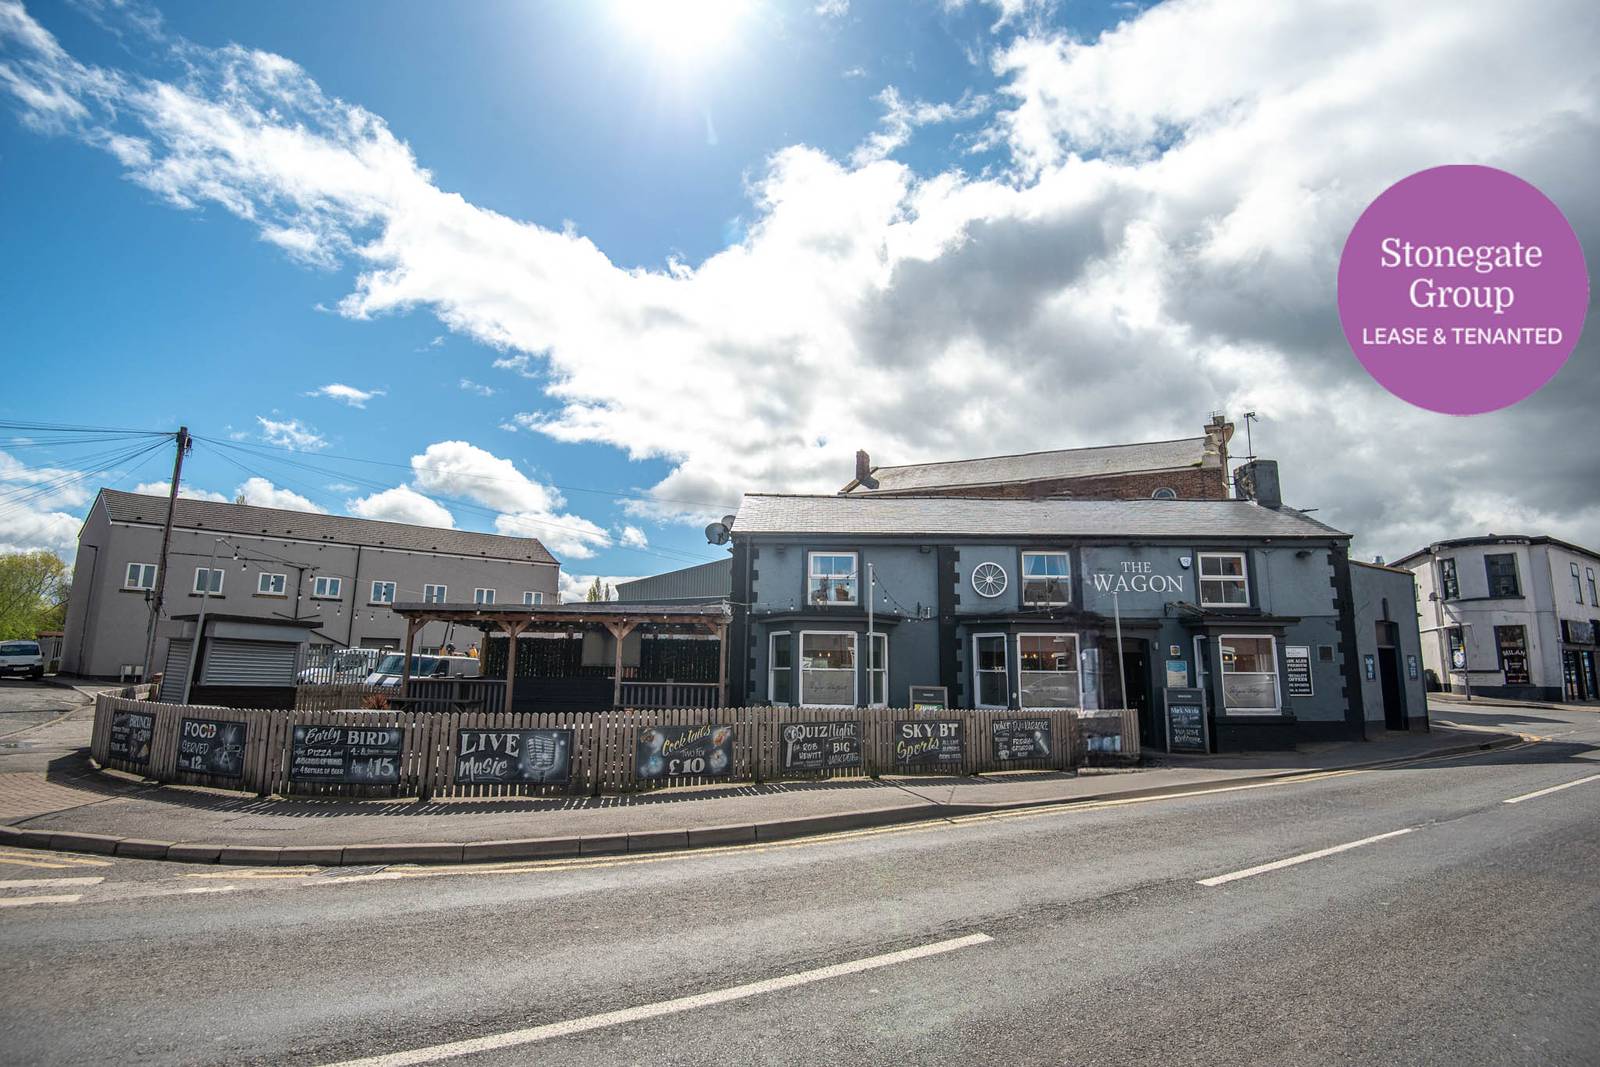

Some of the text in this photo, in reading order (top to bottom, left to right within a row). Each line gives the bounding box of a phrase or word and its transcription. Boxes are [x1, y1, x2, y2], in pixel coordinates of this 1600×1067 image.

[1121, 561, 1152, 573] THE
[1093, 574, 1184, 592] WAGON
[184, 721, 217, 738] FOOD
[305, 727, 390, 745] Early BIRD
[796, 724, 828, 742] QUIZ
[902, 723, 959, 738] SKY BT
[182, 740, 209, 754] SERVED
[460, 734, 520, 757] LIVE
[662, 725, 711, 757] Cocktails
[803, 743, 818, 751] ROB
[833, 742, 850, 753] BIG
[799, 752, 821, 760] HEWITT
[897, 737, 940, 764] Sports
[460, 757, 508, 781] Music
